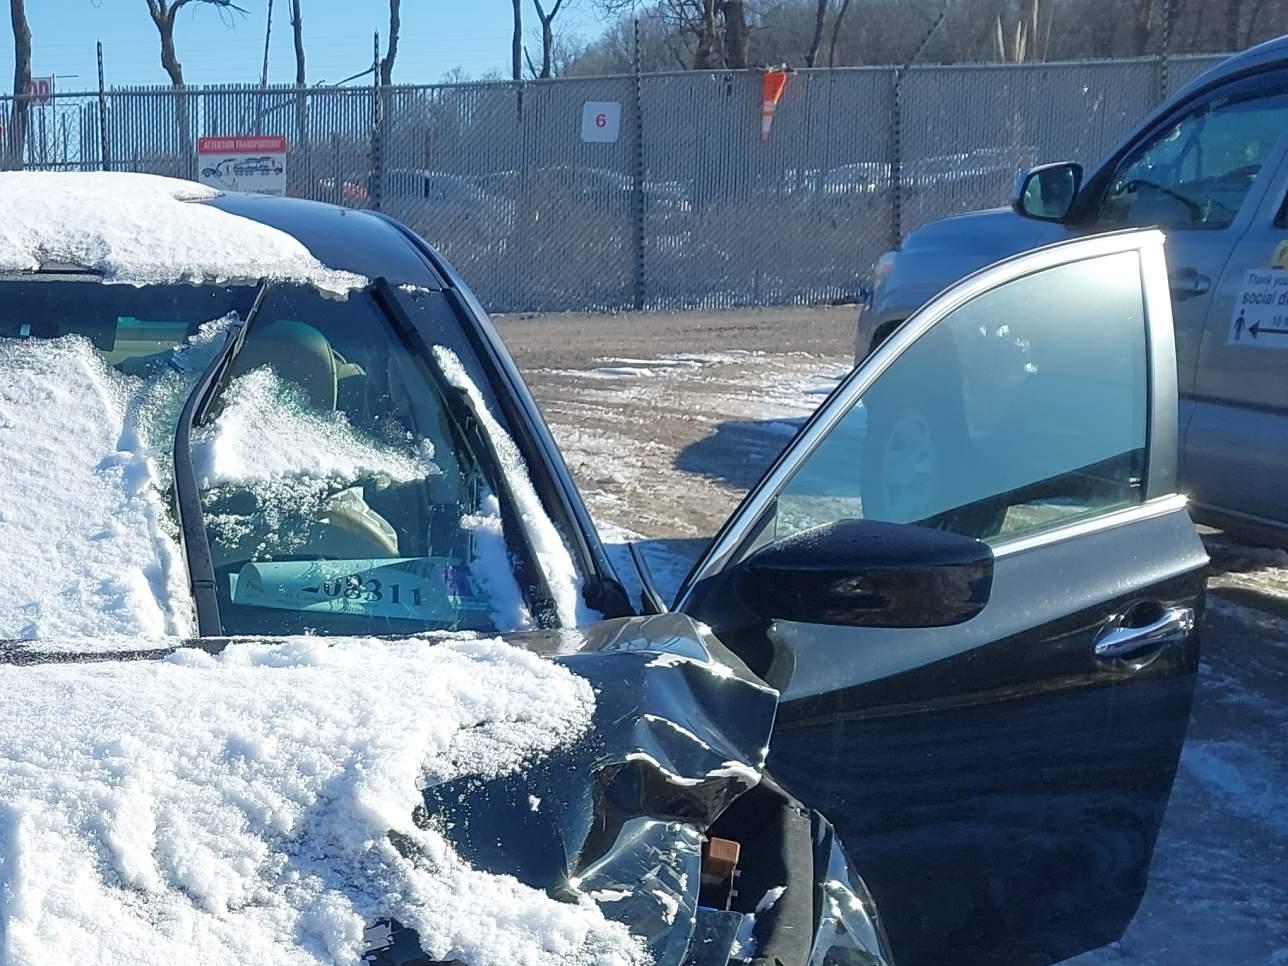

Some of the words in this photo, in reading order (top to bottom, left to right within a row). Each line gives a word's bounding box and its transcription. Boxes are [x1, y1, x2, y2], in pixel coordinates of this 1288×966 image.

[595, 113, 607, 128] 6
[203, 139, 234, 150] ATTENTION
[1249, 273, 1272, 285] Thank
[1242, 289, 1277, 305] social
